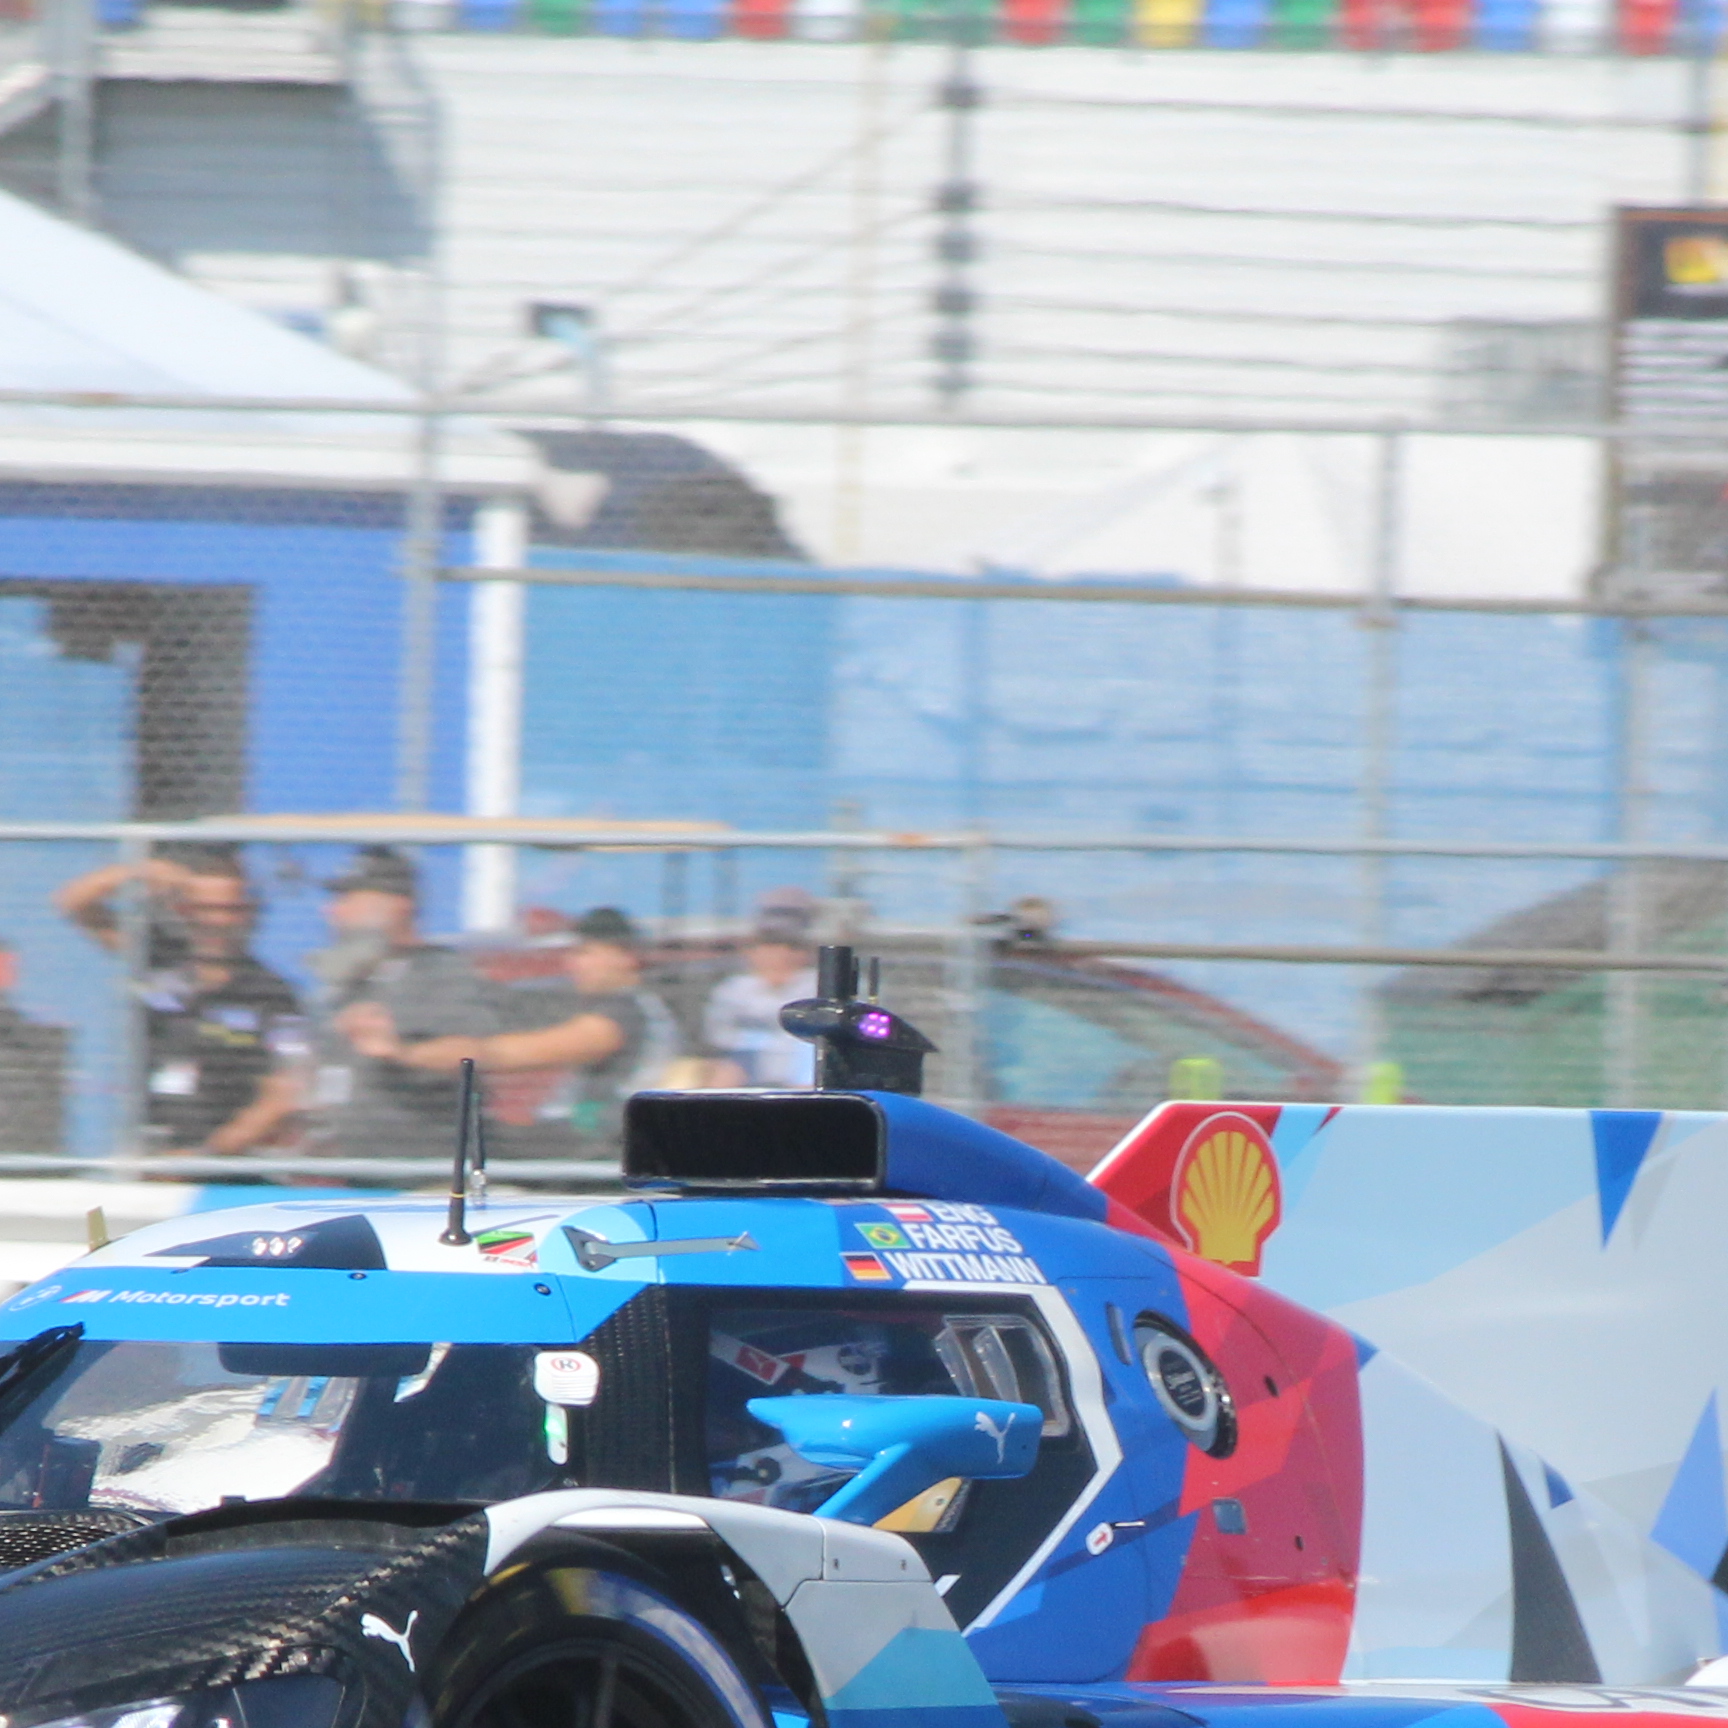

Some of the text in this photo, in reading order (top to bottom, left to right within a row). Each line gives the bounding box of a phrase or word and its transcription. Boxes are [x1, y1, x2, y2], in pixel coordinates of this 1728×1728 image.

[925, 1202, 1000, 1225] ENG
[901, 1222, 1024, 1253] FARFUS
[882, 1251, 1048, 1284] WITTMANN
[108, 1290, 291, 1308] Motorsport
